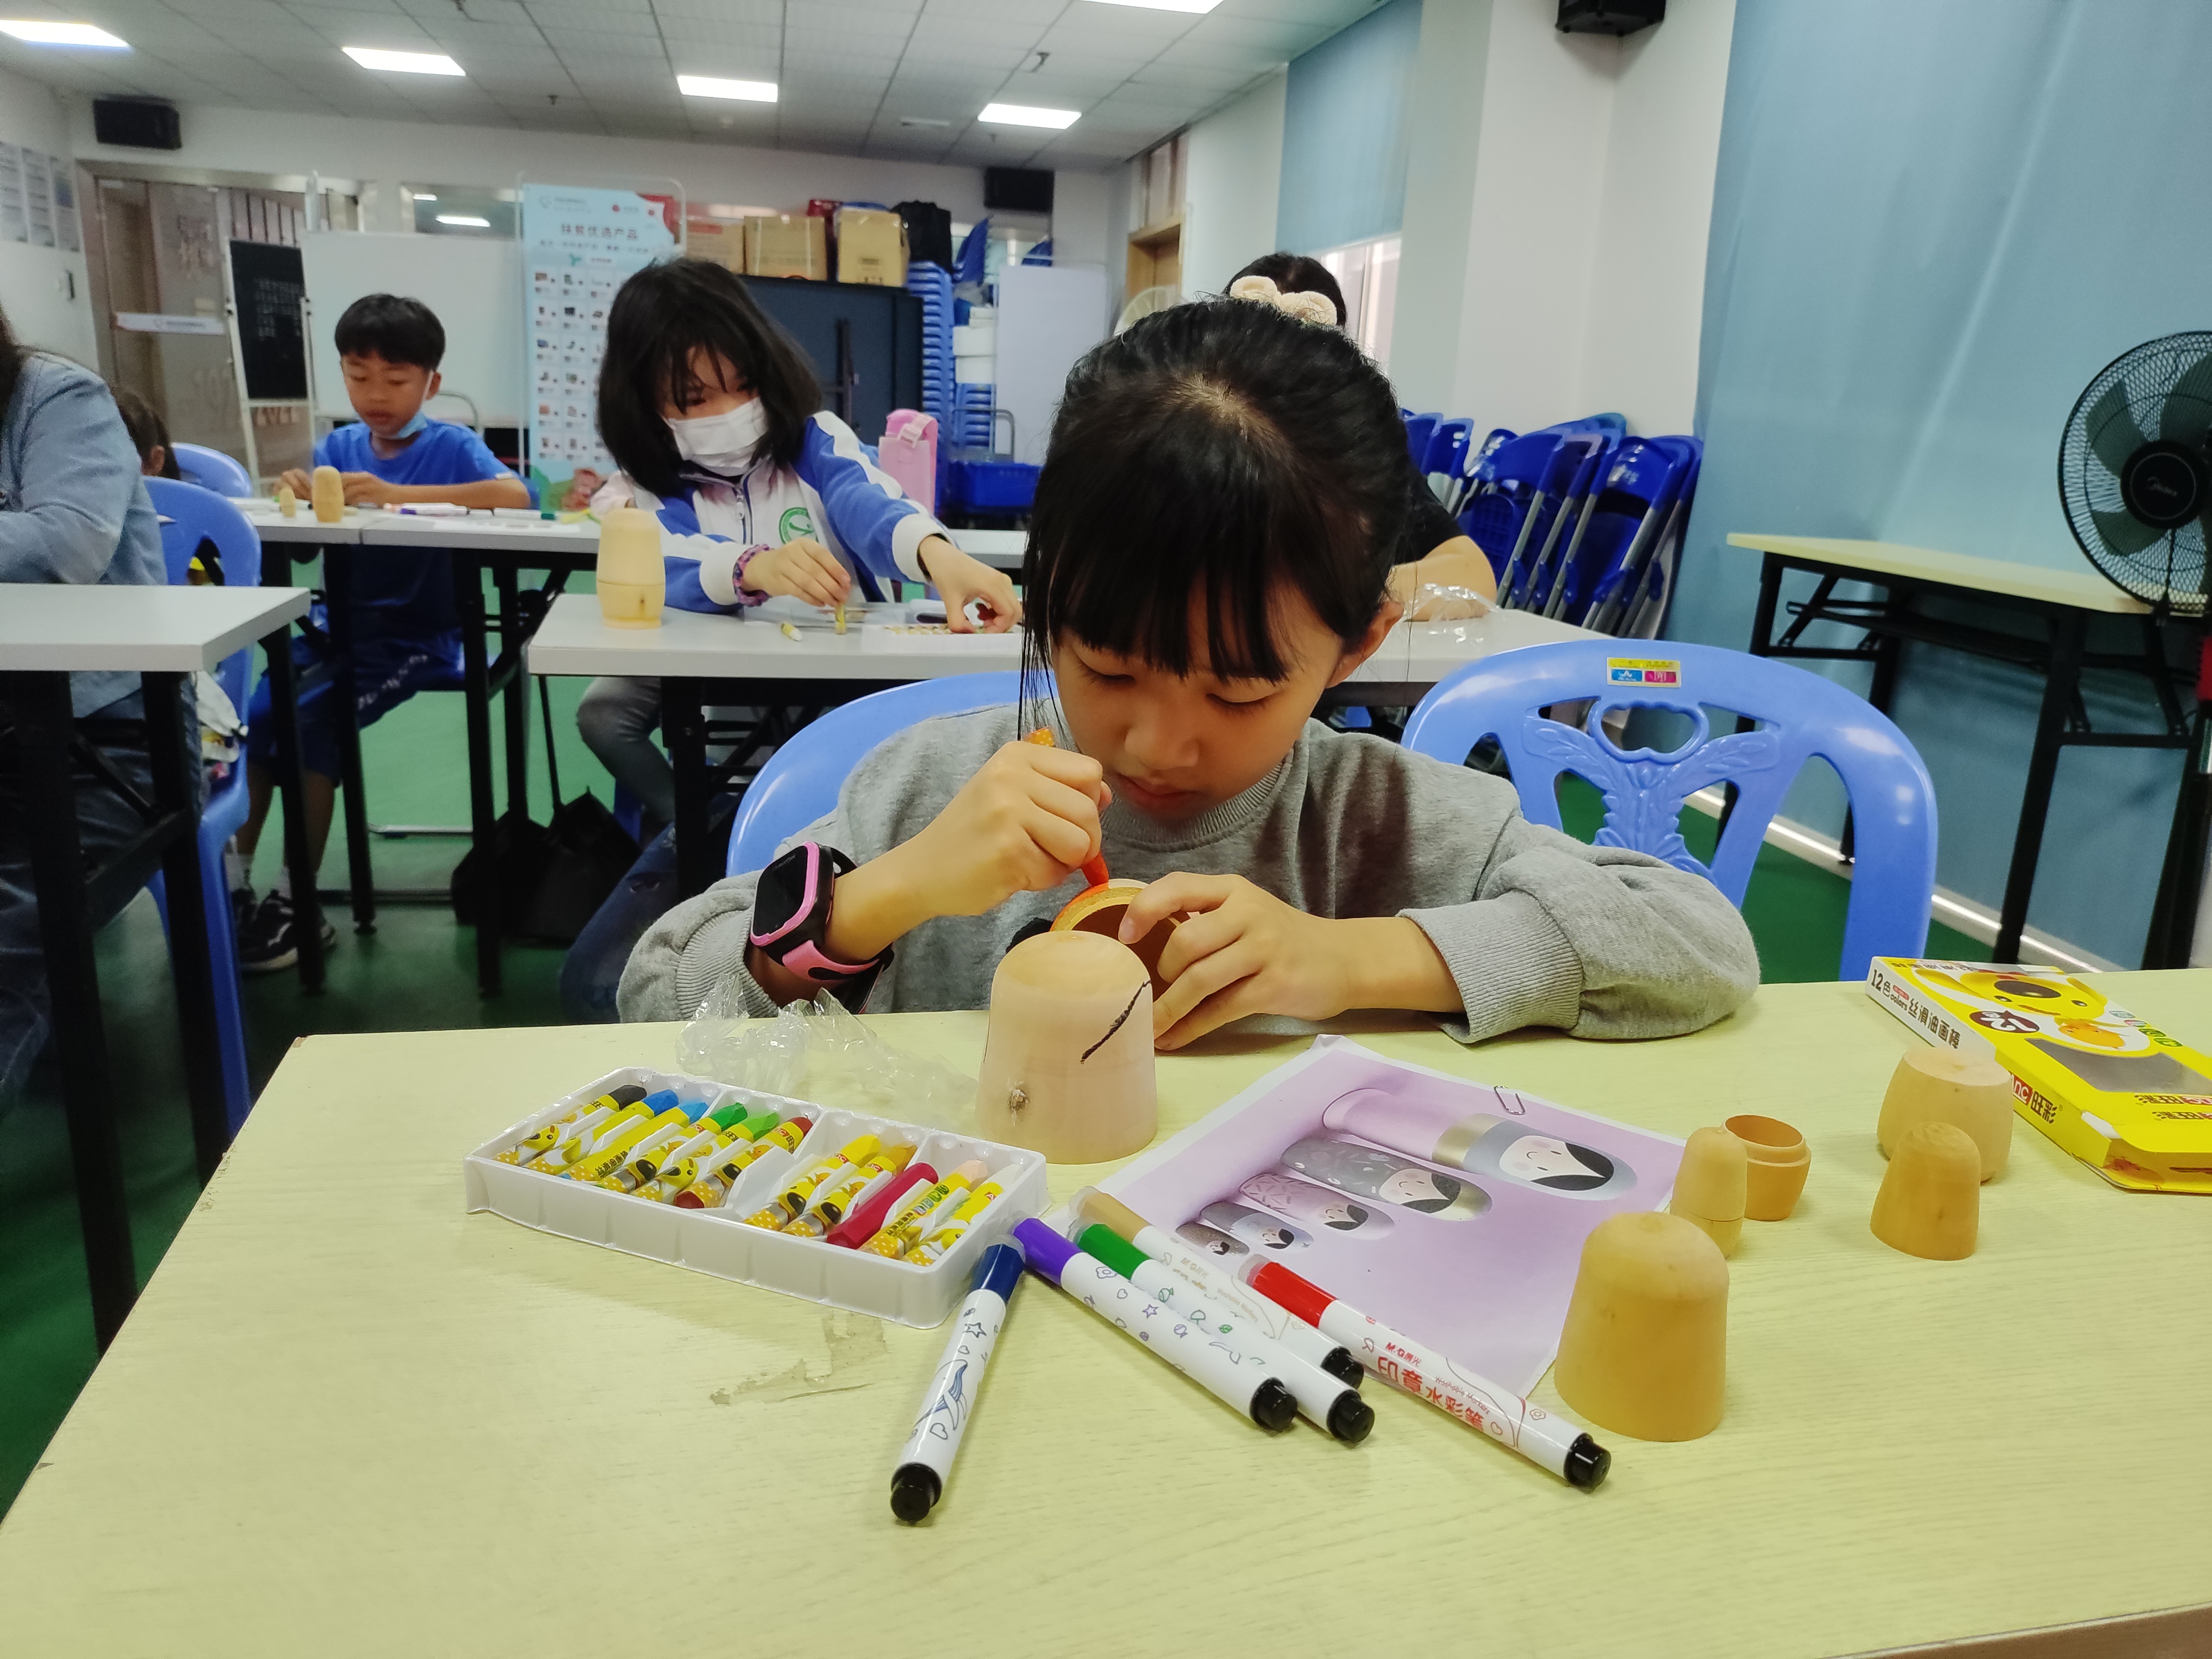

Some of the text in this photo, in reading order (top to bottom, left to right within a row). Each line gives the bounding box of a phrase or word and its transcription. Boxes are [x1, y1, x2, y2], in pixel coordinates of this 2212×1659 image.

[1907, 998, 1961, 1050] 丝滑油画棒
[1377, 1355, 1485, 1432] 印章水彩笔
[1434, 1376, 1490, 1415] Washable Markers
